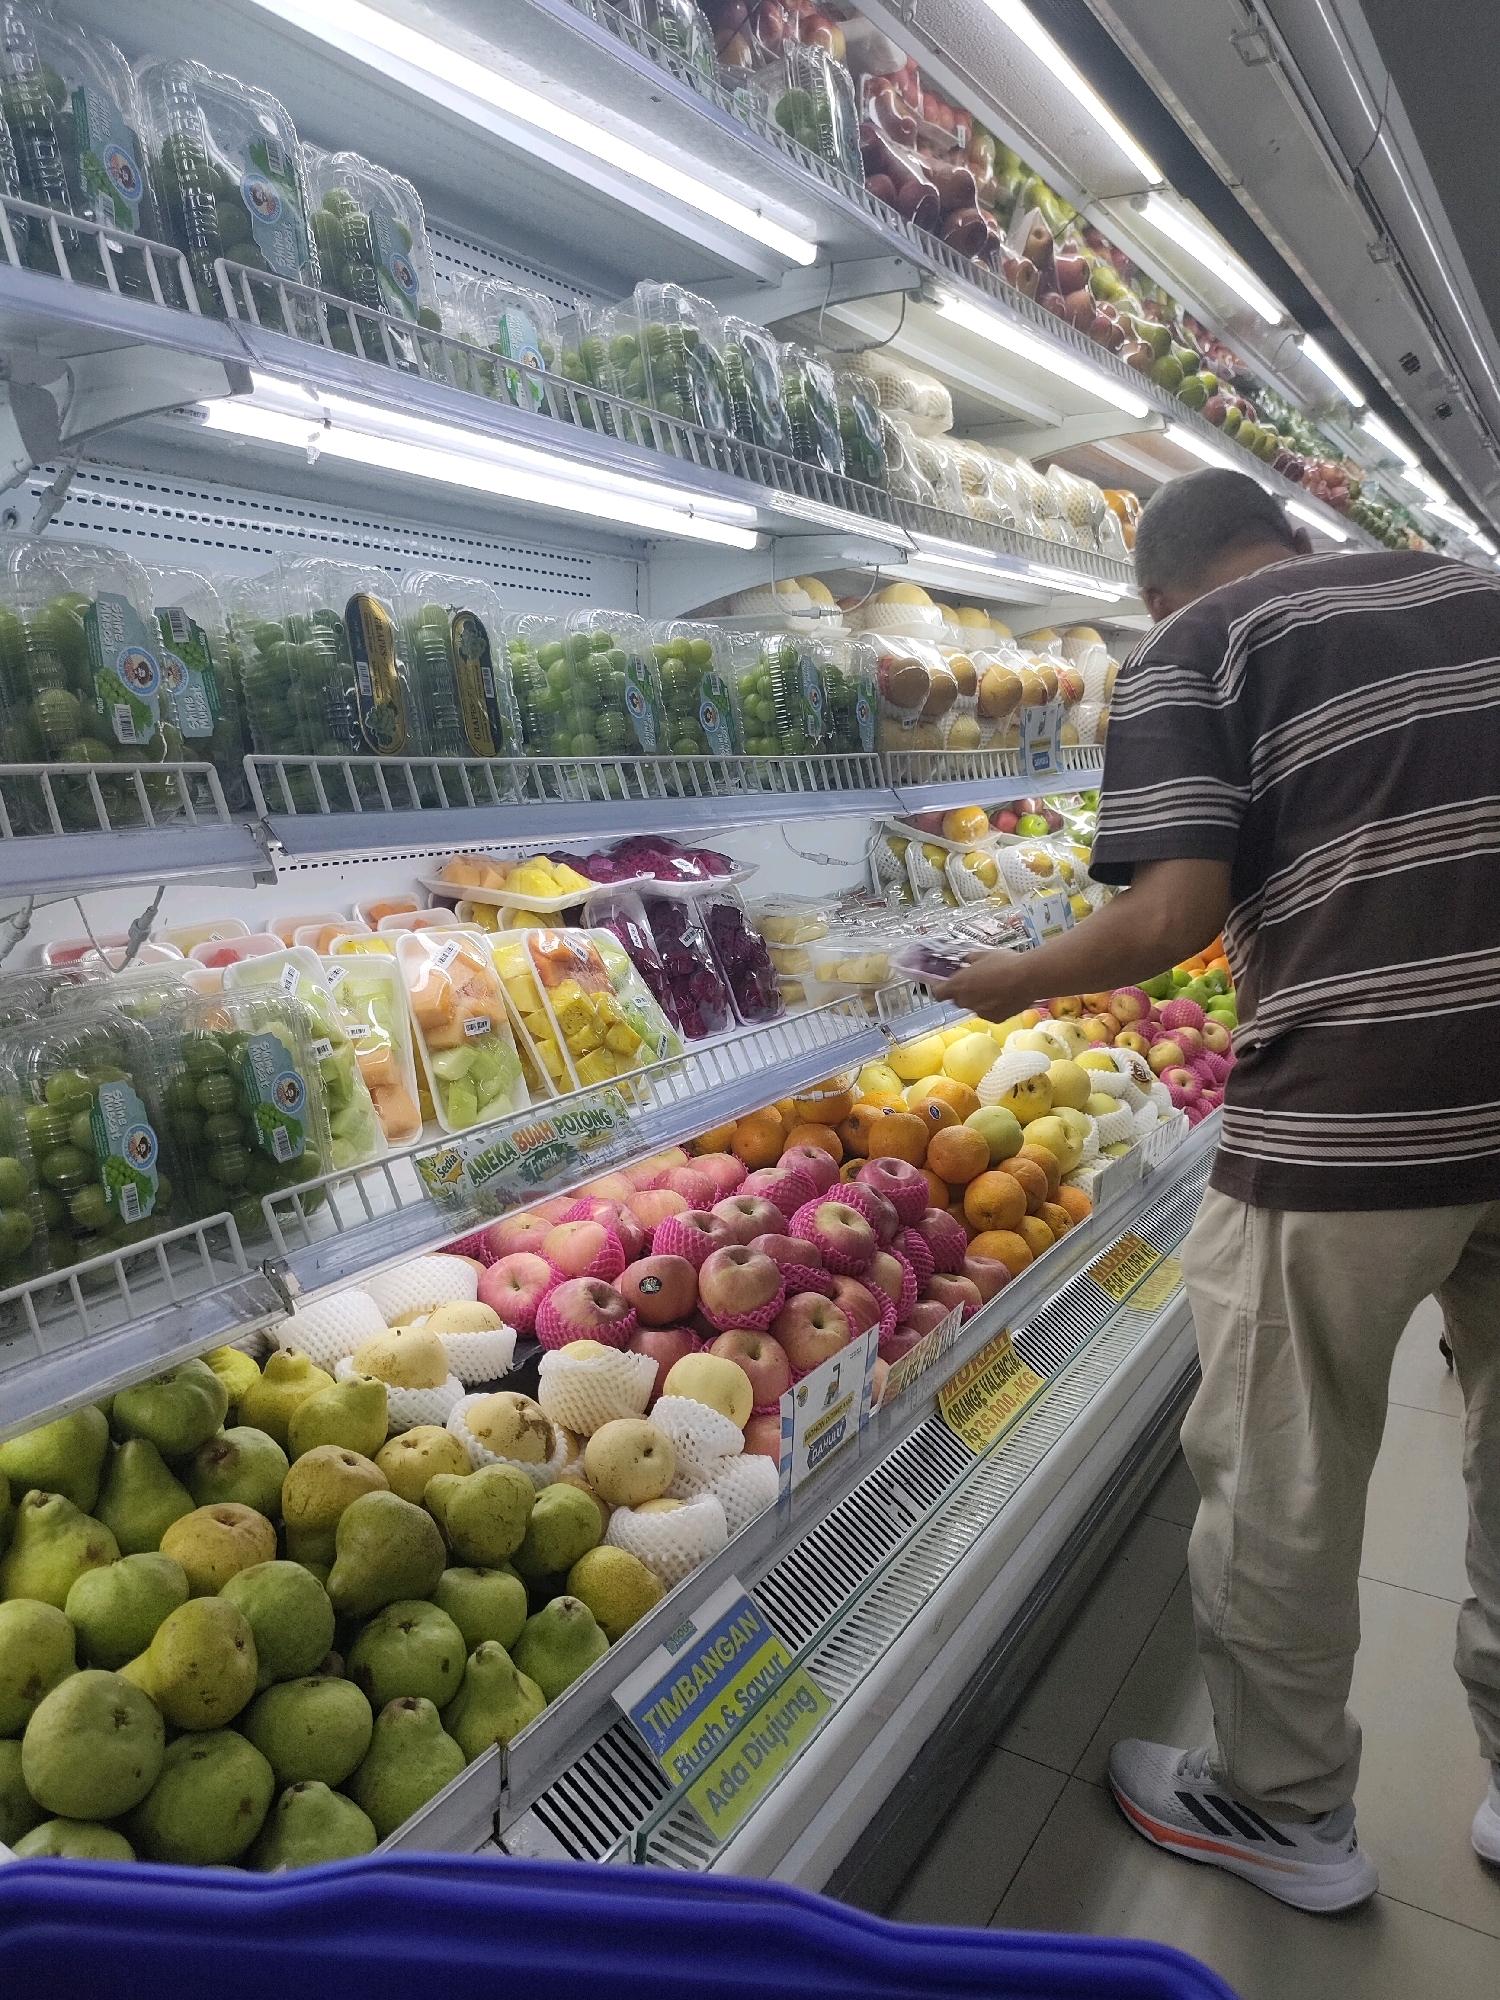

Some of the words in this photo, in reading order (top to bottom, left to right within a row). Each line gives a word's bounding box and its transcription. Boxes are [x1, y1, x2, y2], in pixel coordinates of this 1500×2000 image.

[100, 601, 117, 654] Muscat
[111, 602, 124, 643] Shine
[184, 695, 199, 730] Shine
[190, 684, 212, 730] Muscat
[250, 1044, 271, 1090] Muscat
[260, 1040, 275, 1075] Shine
[101, 1091, 122, 1142] Muscat
[111, 1088, 127, 1127] Shine
[436, 1153, 459, 1180] Sedia
[465, 1138, 517, 1187] ANEKA
[511, 1119, 557, 1153] BUAH
[554, 1107, 615, 1139] POTONG
[526, 1148, 562, 1178] Fresh
[1089, 1234, 1140, 1281] MURAH
[1102, 1271, 1130, 1299] PEAR
[1118, 1250, 1148, 1283] GOLDEN
[1138, 1243, 1159, 1265] KG
[940, 1328, 1009, 1402] MURAH
[948, 1382, 988, 1430] ORANGE
[979, 1349, 1023, 1398] VALENCIA
[811, 1425, 843, 1464] DAHULU
[641, 1609, 761, 1739] TIMBANGAN
[672, 1718, 726, 1782] Buah
[719, 1704, 738, 1726] &
[733, 1651, 789, 1712] Sayur
[703, 1765, 750, 1817] Ada
[743, 1684, 820, 1771] Diujung
